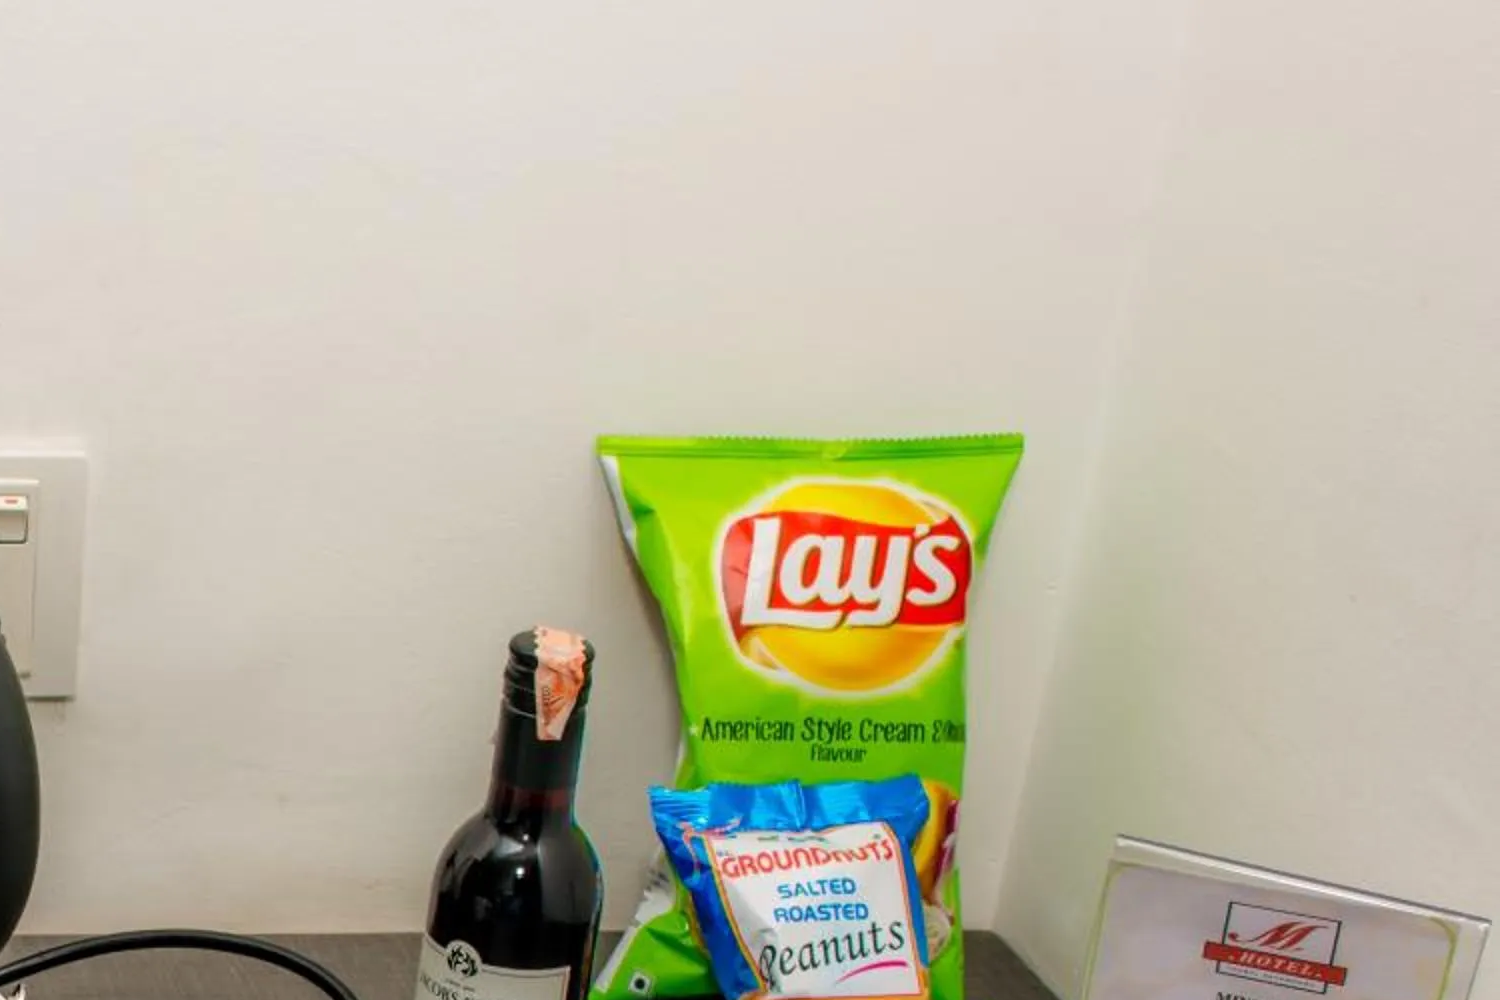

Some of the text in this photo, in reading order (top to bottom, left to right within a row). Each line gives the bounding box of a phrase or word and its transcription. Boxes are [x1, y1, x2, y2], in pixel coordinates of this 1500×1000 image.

[740, 516, 961, 630] Lay's
[701, 717, 795, 742] American
[800, 717, 852, 744] Style
[859, 719, 925, 743] Cream
[810, 743, 867, 763] Flavour
[777, 877, 857, 899] SALTED
[774, 903, 869, 923] ROASTED
[758, 920, 906, 991] Peanuts
[1238, 951, 1316, 977] HOTEL
